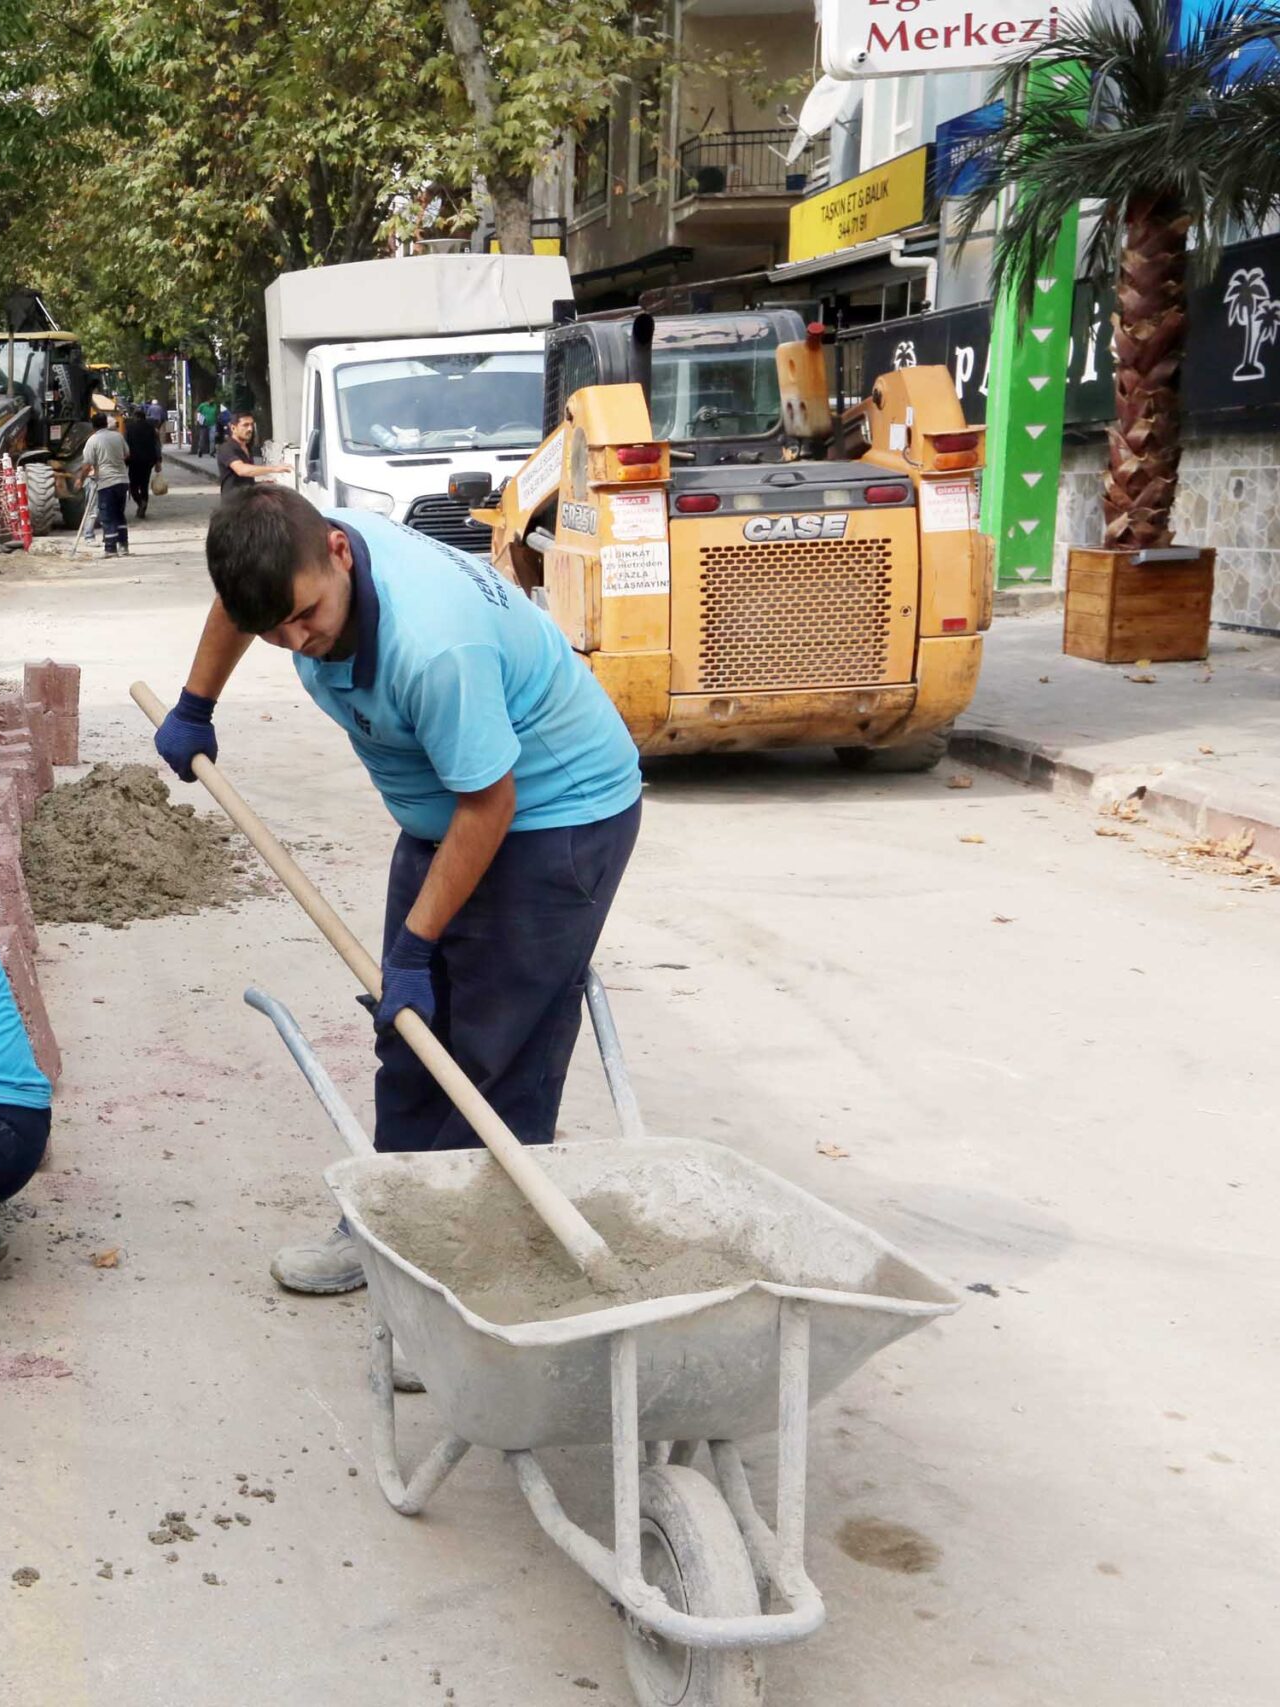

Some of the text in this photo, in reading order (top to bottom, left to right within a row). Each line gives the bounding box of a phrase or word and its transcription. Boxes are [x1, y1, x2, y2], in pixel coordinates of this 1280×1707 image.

[867, 6, 1059, 53] Merkezi
[847, 191, 857, 214] ET
[743, 513, 849, 542] CASE
[494, 581, 510, 610] FEN
